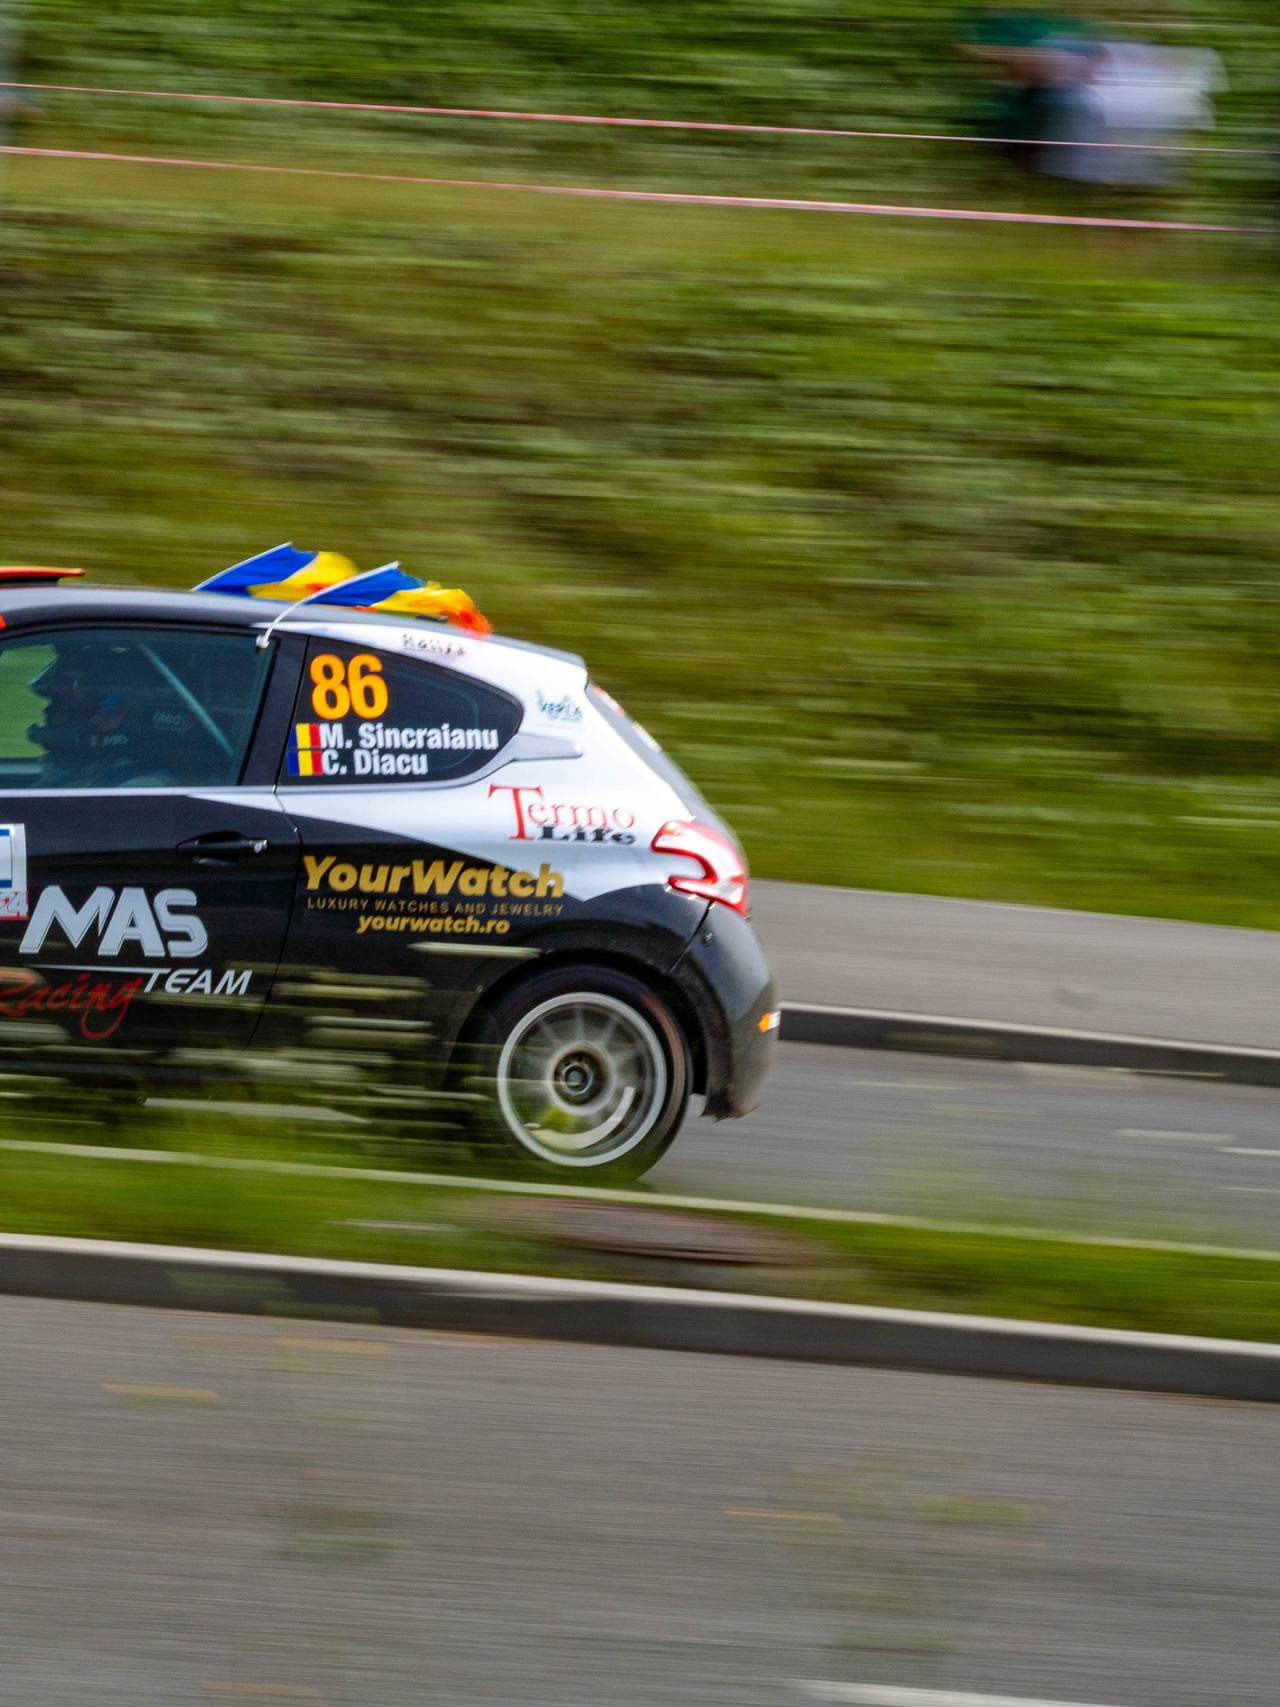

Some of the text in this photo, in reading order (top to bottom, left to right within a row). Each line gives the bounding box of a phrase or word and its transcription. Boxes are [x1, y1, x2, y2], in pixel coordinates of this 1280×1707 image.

[310, 653, 388, 720] 86
[319, 723, 499, 750] M. Sincraianu
[322, 750, 428, 776] C. Diacu
[488, 784, 636, 842] Termo
[537, 825, 638, 845] Life
[303, 855, 565, 898] YourWatch
[307, 897, 565, 916] LUXURY WATCHES AND JEWELRY
[19, 885, 208, 958] MAS
[356, 915, 511, 934] yourwatch.ro
[142, 967, 253, 995] TEAM
